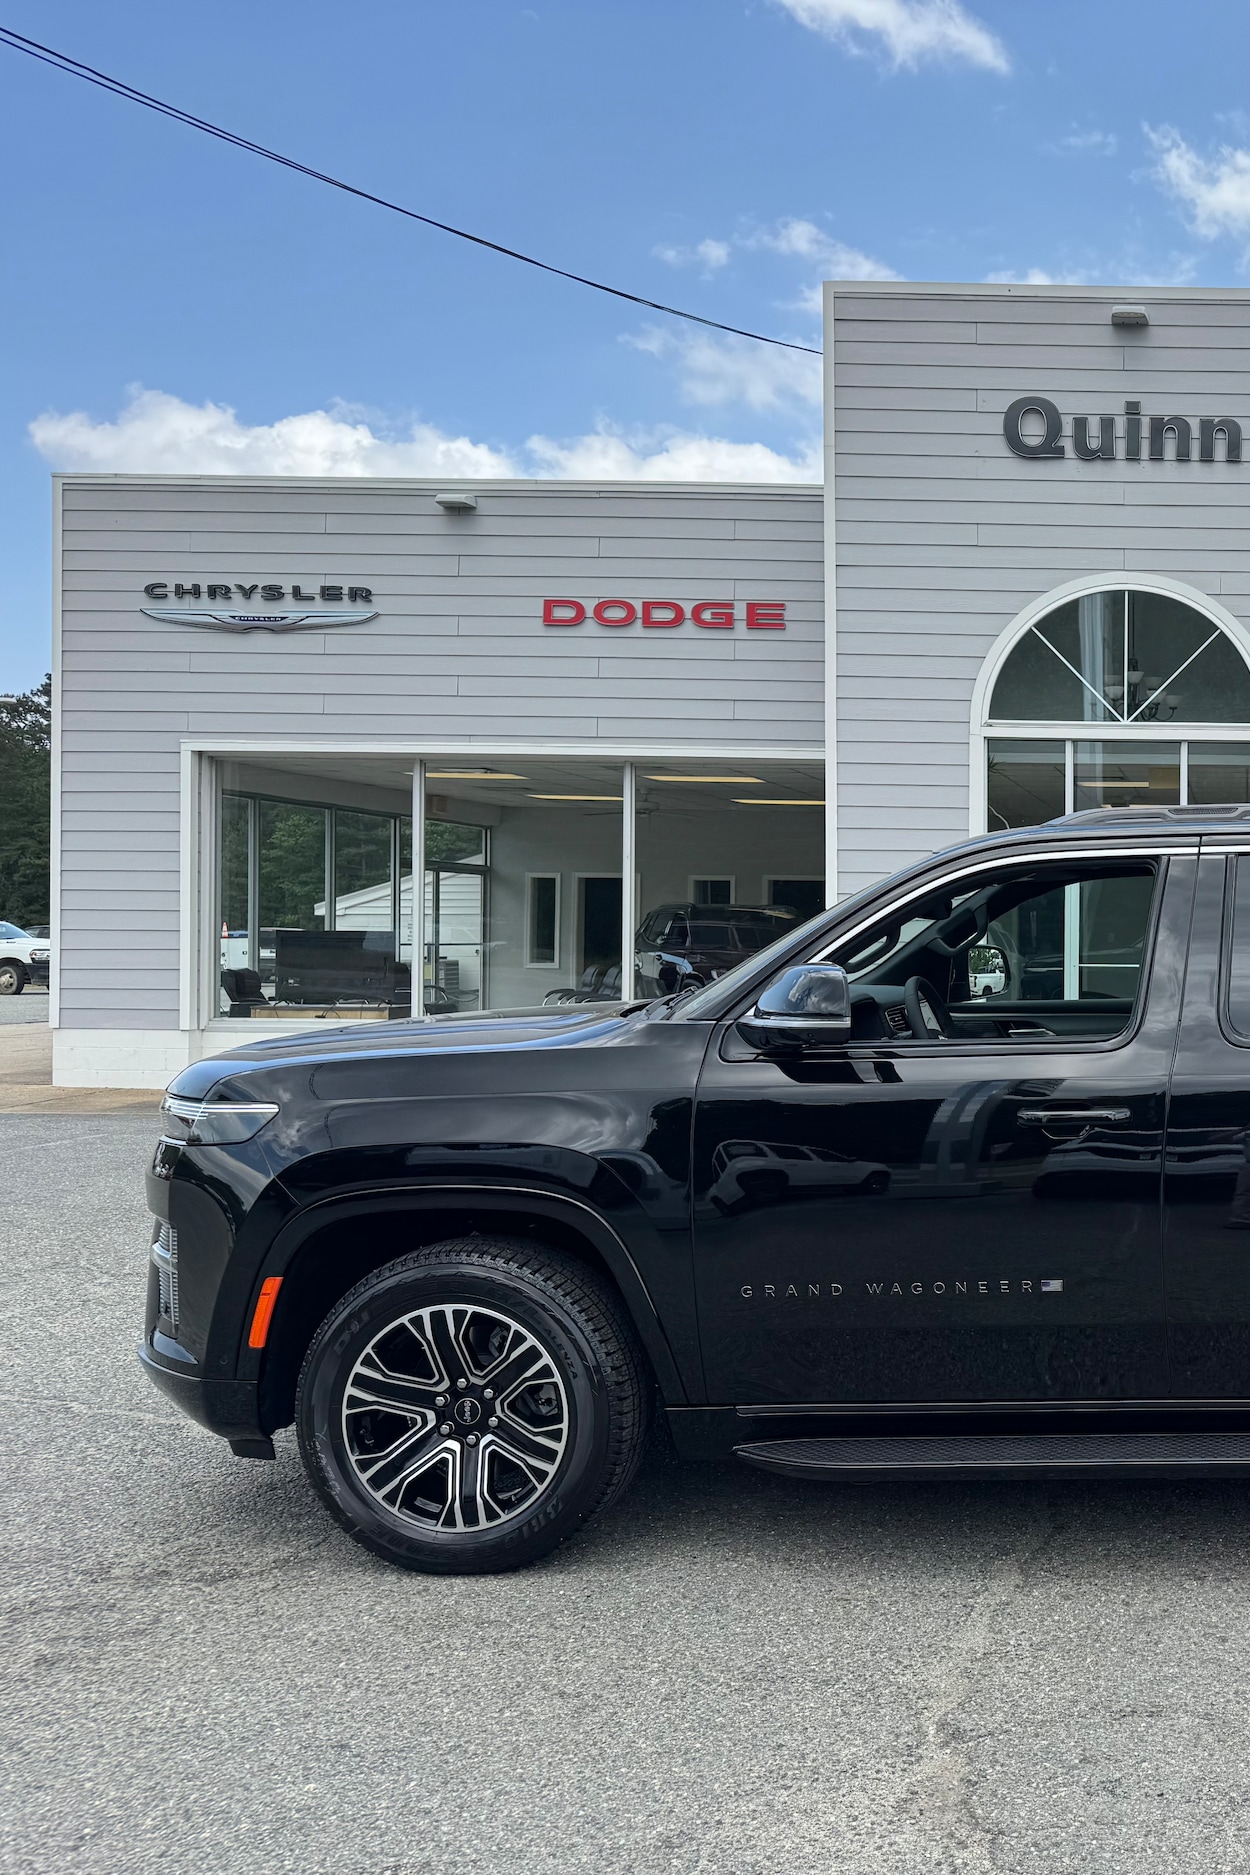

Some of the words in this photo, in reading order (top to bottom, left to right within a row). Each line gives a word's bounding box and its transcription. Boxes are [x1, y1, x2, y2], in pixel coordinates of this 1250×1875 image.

[1003, 396, 1242, 460] Quinn
[144, 583, 373, 602] CHRYSLER
[542, 599, 786, 629] DODGE
[740, 1283, 843, 1298] GRAND
[865, 1280, 1033, 1295] WAGONEER
[543, 1327, 578, 1380] ALENZA
